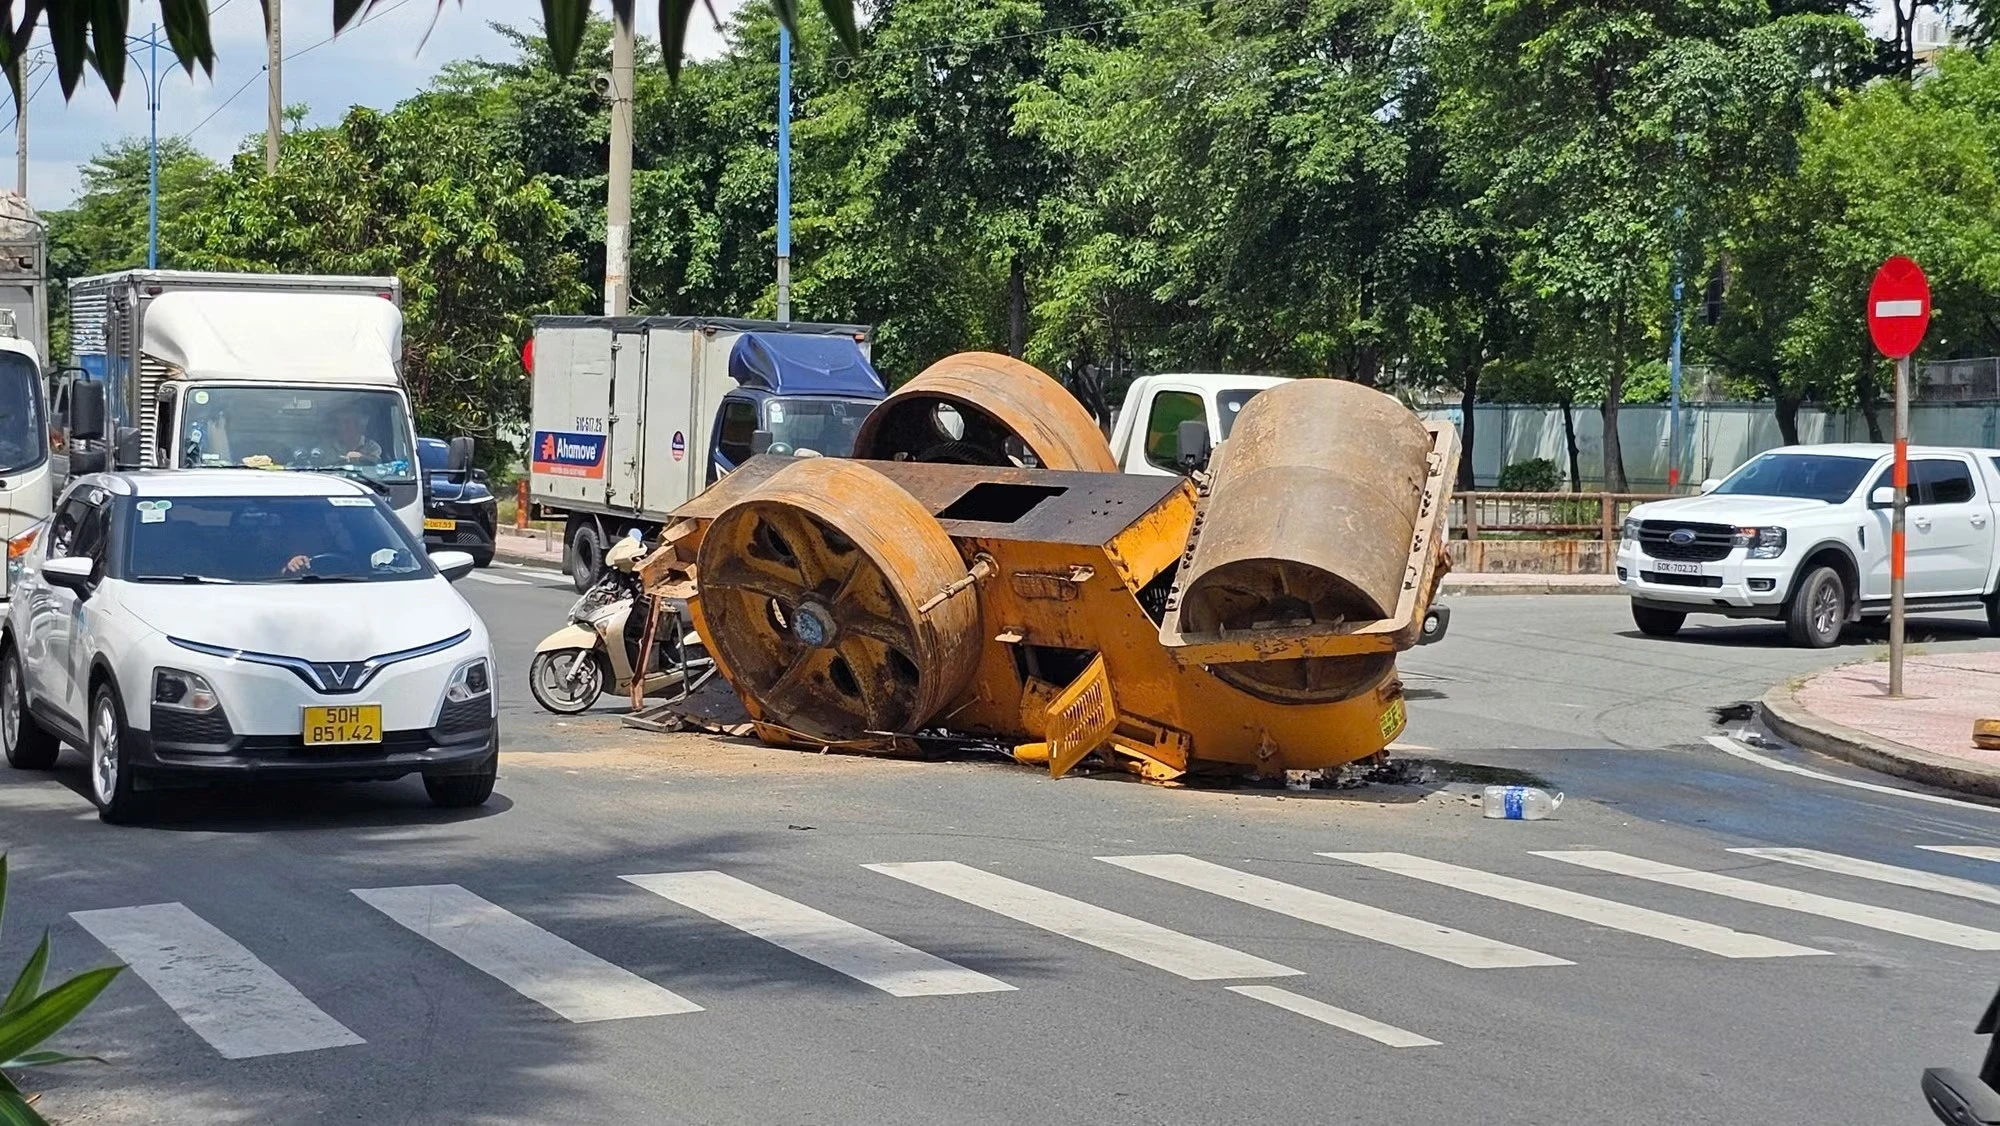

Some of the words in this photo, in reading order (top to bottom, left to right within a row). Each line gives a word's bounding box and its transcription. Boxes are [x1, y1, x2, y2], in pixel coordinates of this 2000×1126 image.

[556, 437, 596, 460] Ahamove
[326, 707, 360, 723] 50H
[313, 725, 373, 742] 851.42
